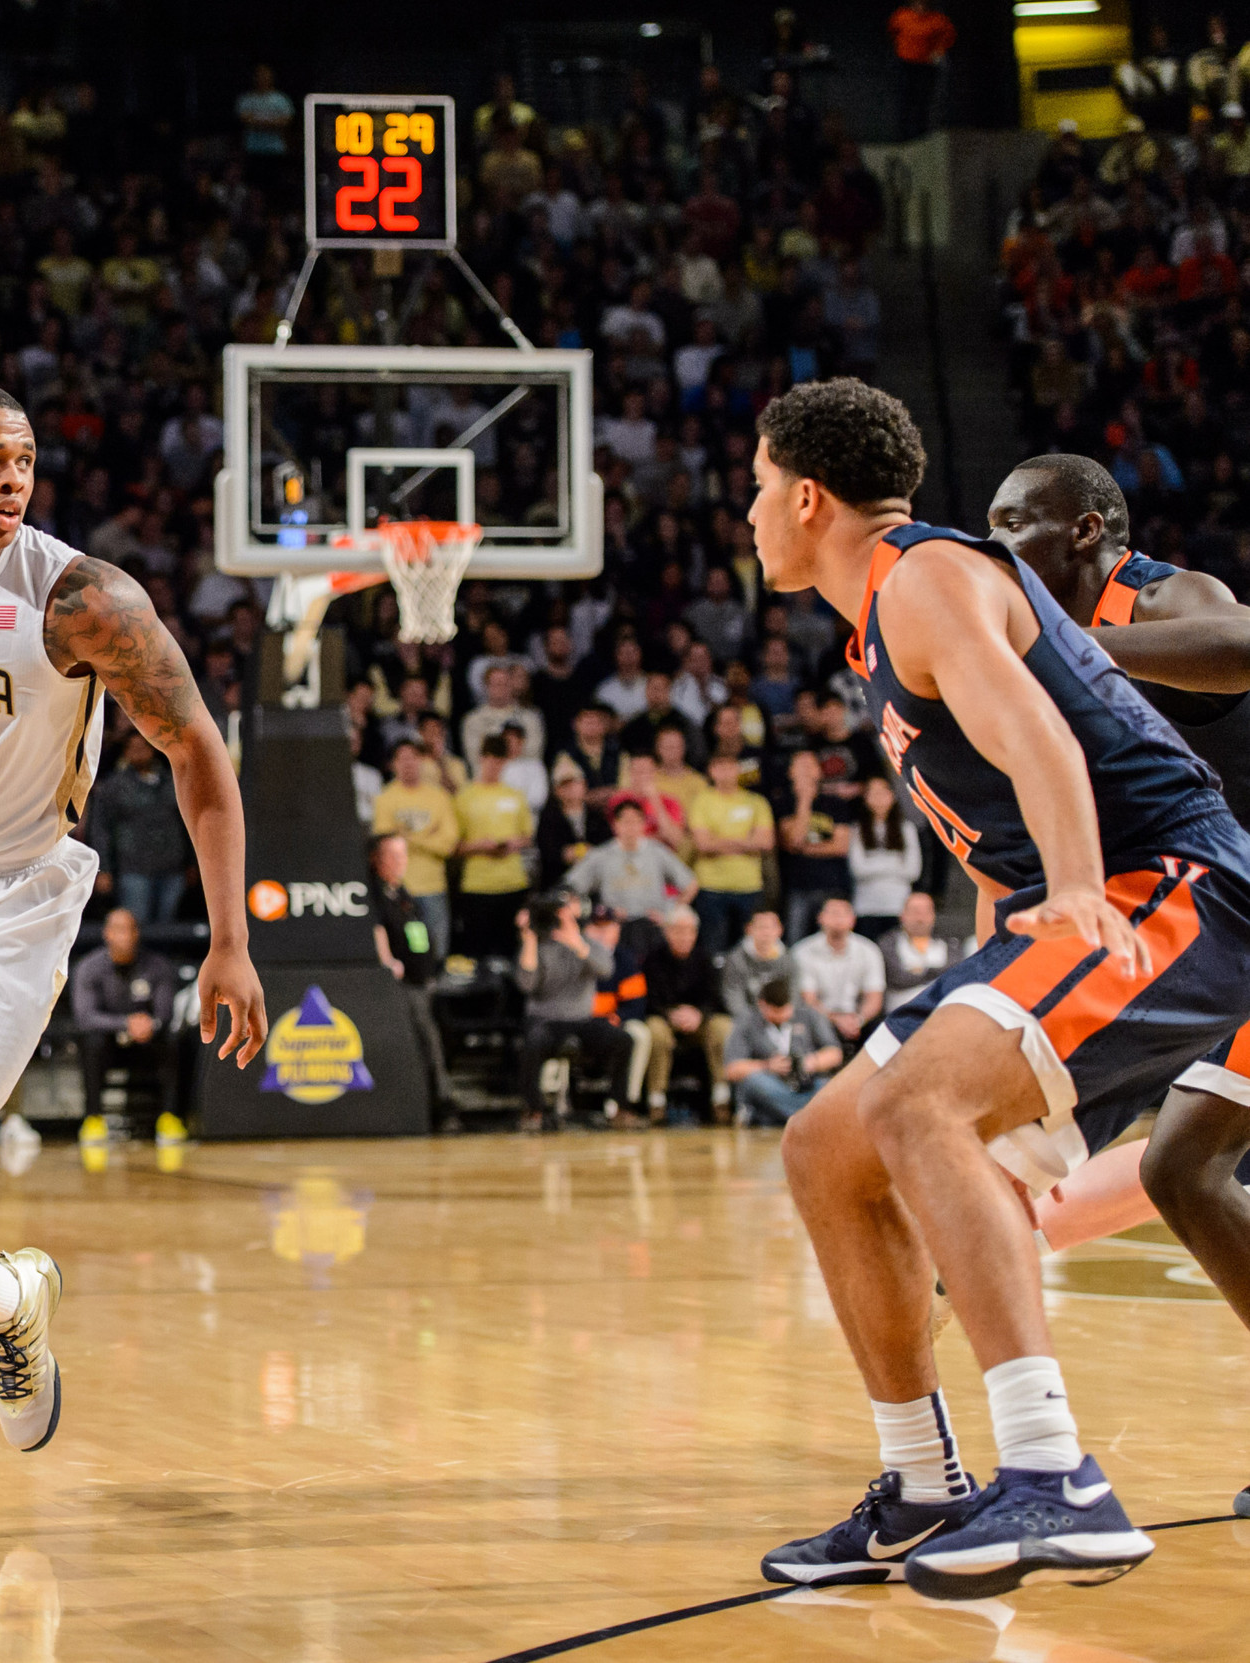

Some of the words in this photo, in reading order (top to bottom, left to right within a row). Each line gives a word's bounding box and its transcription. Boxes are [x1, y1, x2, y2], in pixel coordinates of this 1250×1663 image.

[335, 112, 374, 156] 10
[335, 156, 422, 231] 22
[289, 881, 369, 917] PNC
